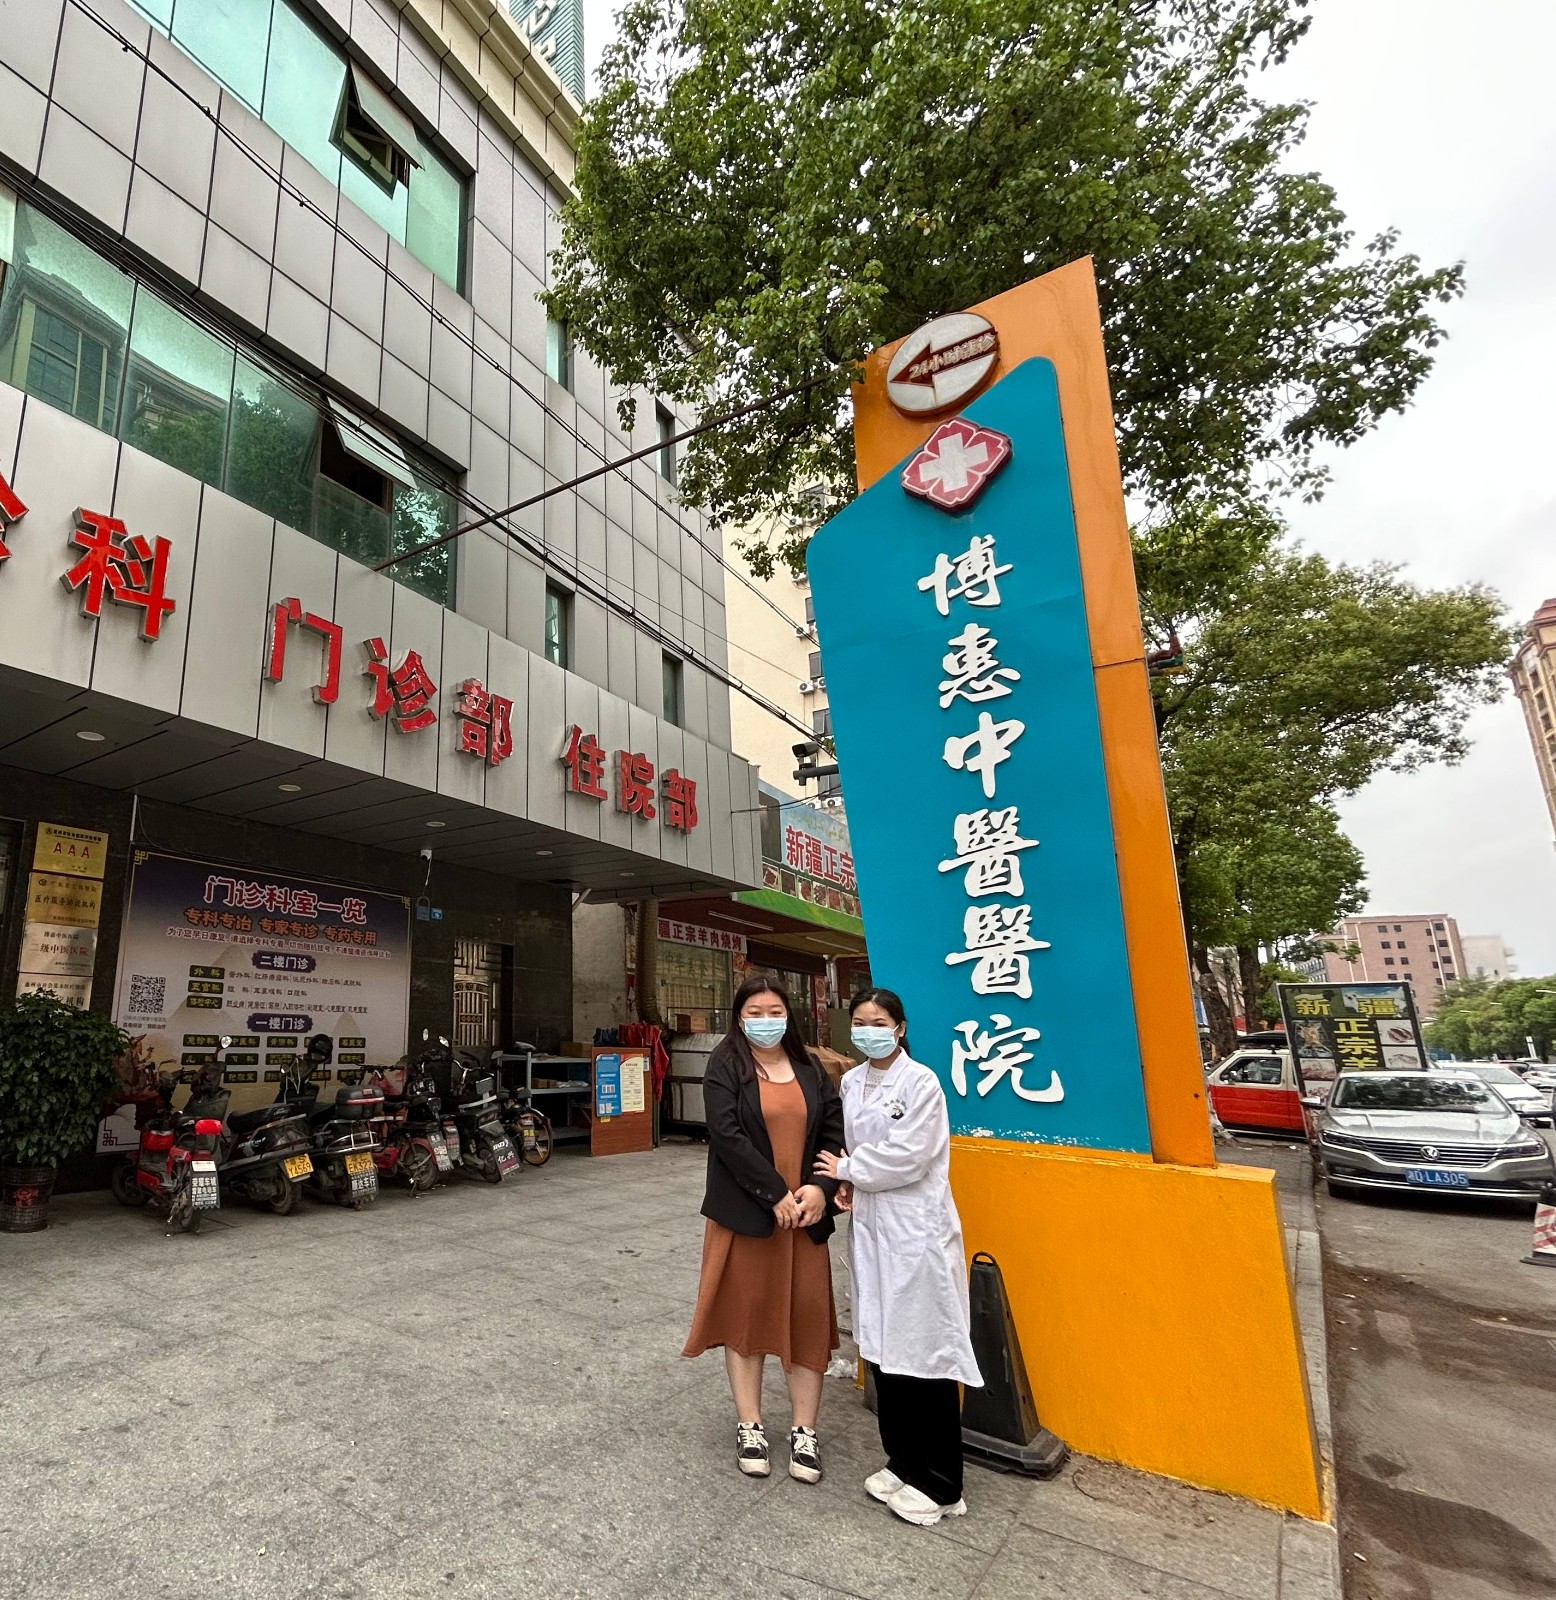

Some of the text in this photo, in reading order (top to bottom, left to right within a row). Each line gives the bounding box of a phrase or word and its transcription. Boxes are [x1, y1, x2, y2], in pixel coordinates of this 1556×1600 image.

[264, 597, 515, 767] 门诊部
[559, 723, 699, 835] 住院部
[917, 533, 1065, 1104] 博惠中醫醫院
[785, 824, 856, 891] 新疆正宗
[204, 875, 367, 924] 门诊科室一览
[184, 907, 379, 946] 专科专治 专家专诊 专药专用
[259, 954, 310, 970] 二楼门诊
[255, 1017, 306, 1031] 一楼门诊
[1295, 998, 1396, 1016] 新疆
[288, 1162, 312, 1176] Y4569
